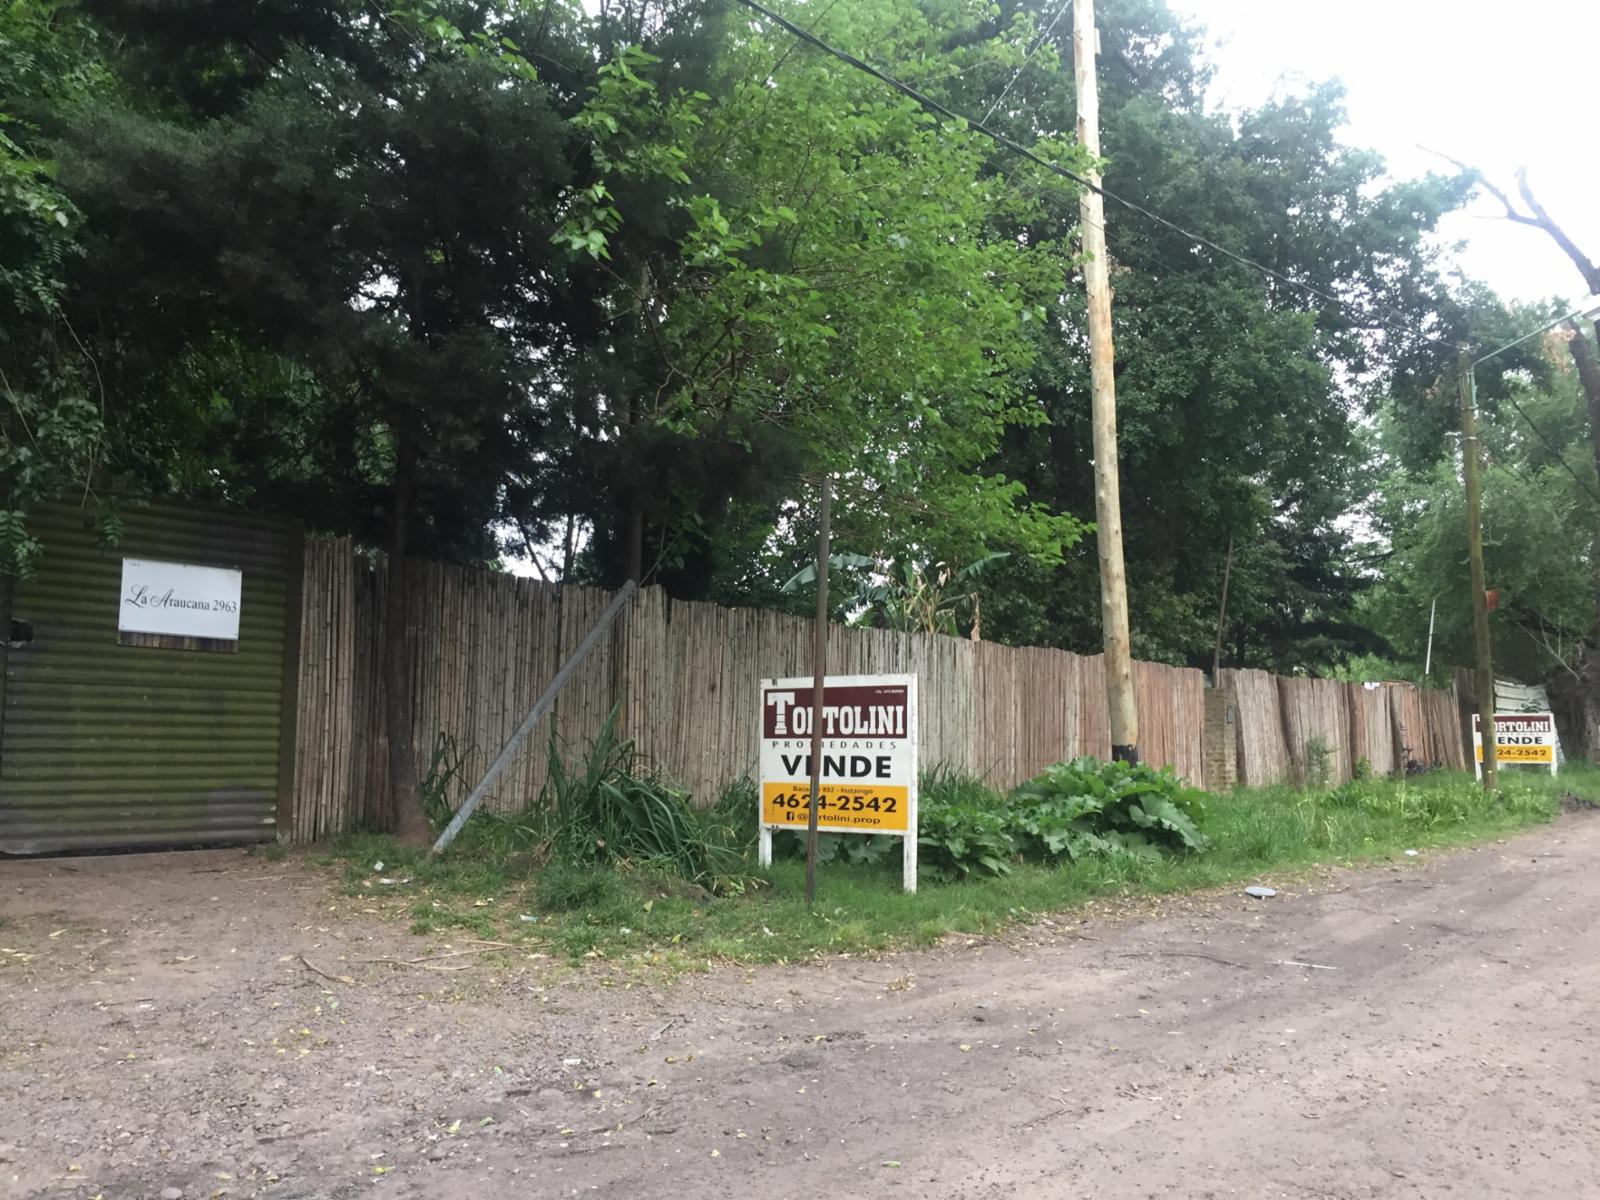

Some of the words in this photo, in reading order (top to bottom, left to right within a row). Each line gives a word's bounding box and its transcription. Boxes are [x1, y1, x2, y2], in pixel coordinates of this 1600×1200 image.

[125, 584, 149, 608] La
[150, 588, 210, 610] Araucana
[211, 599, 237, 613] 2963
[772, 741, 897, 749] PROIEDADES
[1498, 736, 1543, 744] ENDE
[772, 793, 897, 813] 4624-2542
[797, 812, 881, 825] @rtolini.prop
